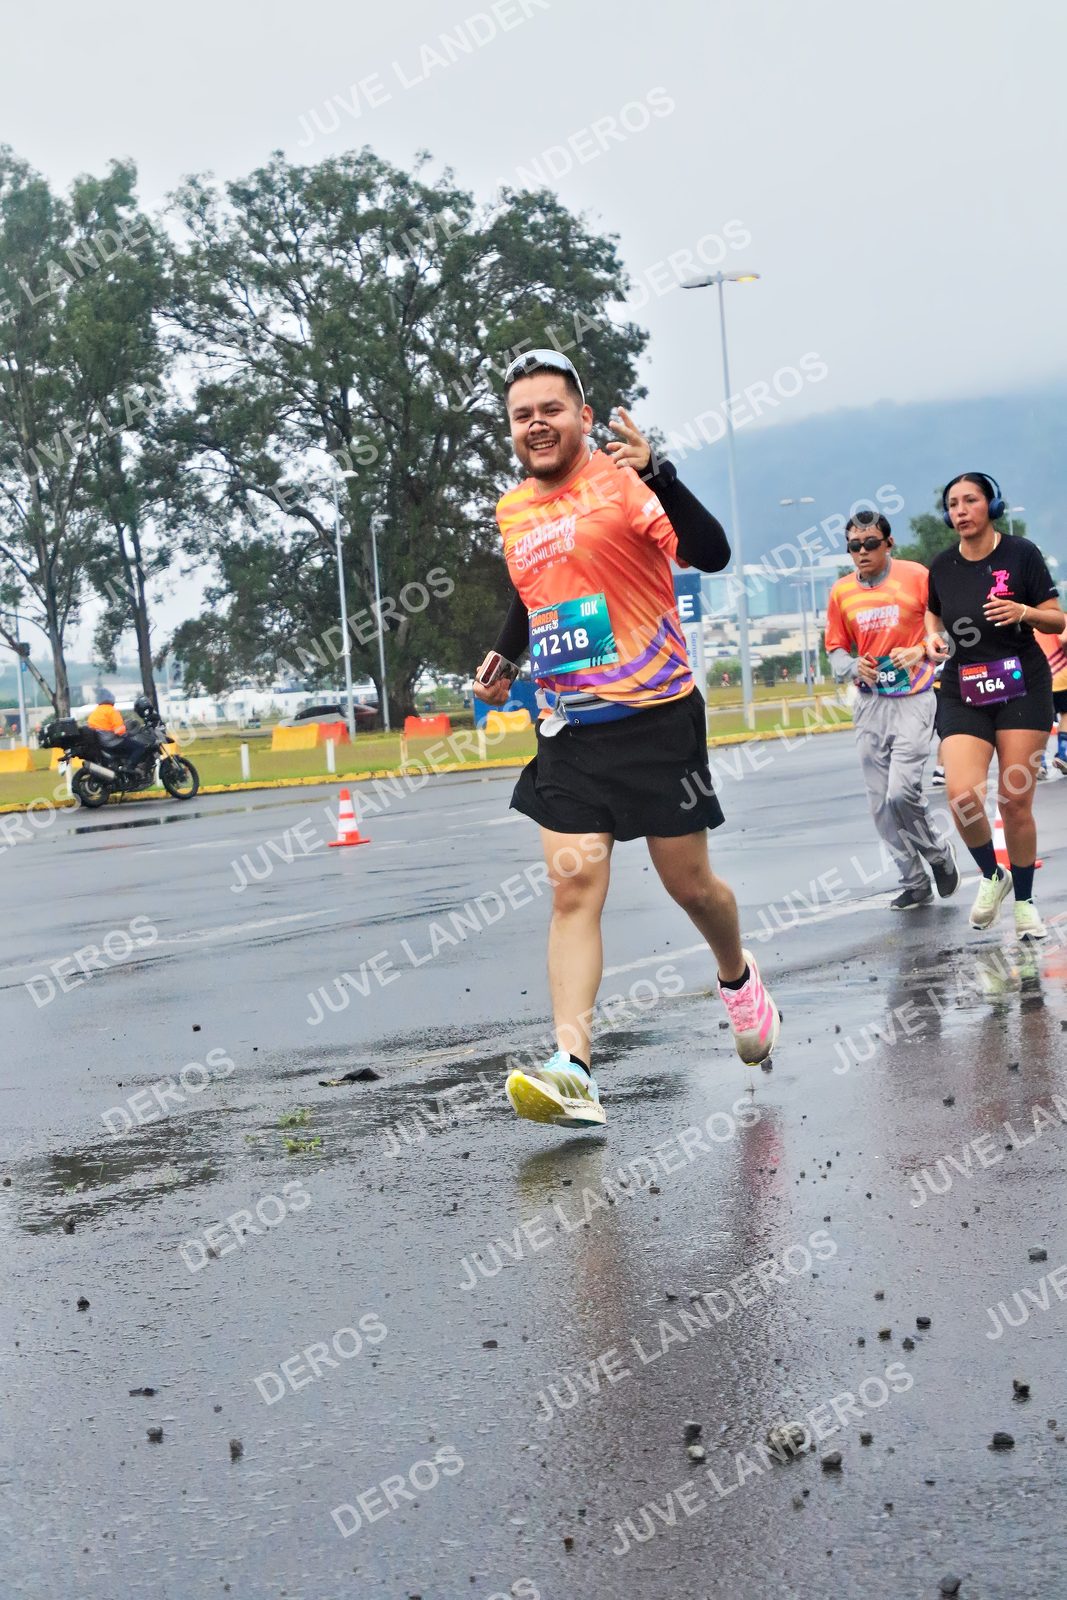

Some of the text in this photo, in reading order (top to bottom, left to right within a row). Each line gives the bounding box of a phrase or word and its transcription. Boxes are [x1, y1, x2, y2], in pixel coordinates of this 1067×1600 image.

[580, 600, 598, 616] 10K
[540, 628, 589, 656] 1218
[876, 671, 896, 683] 98
[976, 678, 1005, 693] 164
